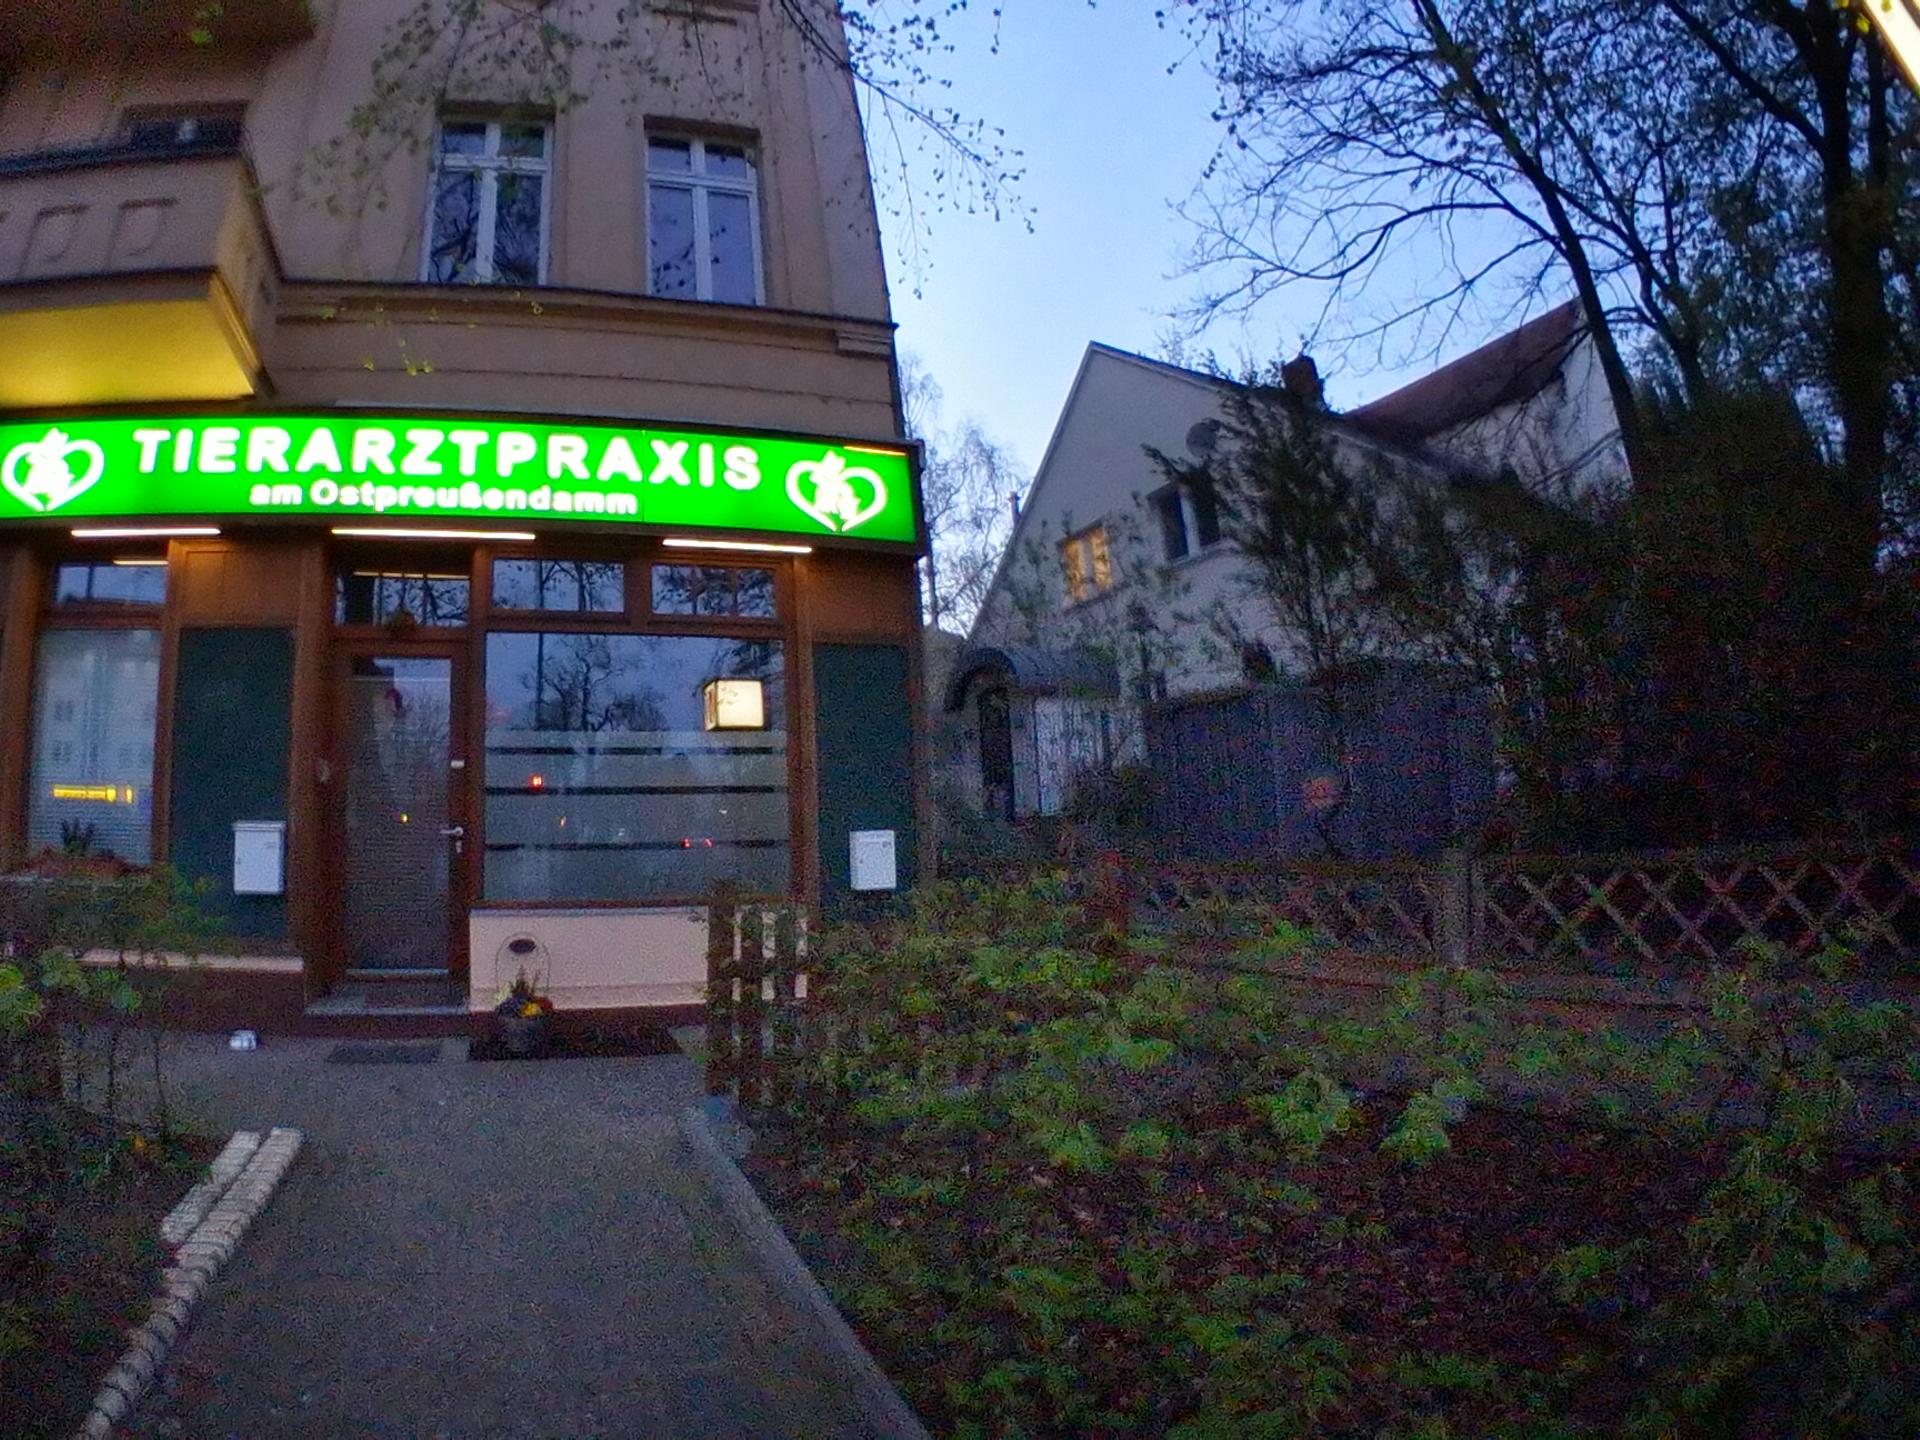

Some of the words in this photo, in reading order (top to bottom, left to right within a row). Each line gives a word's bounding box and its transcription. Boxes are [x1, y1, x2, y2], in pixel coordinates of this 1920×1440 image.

[132, 427, 762, 490] TIERARZTPRAXIS
[249, 484, 302, 506] am
[311, 480, 638, 514] Ostpreußendamm
